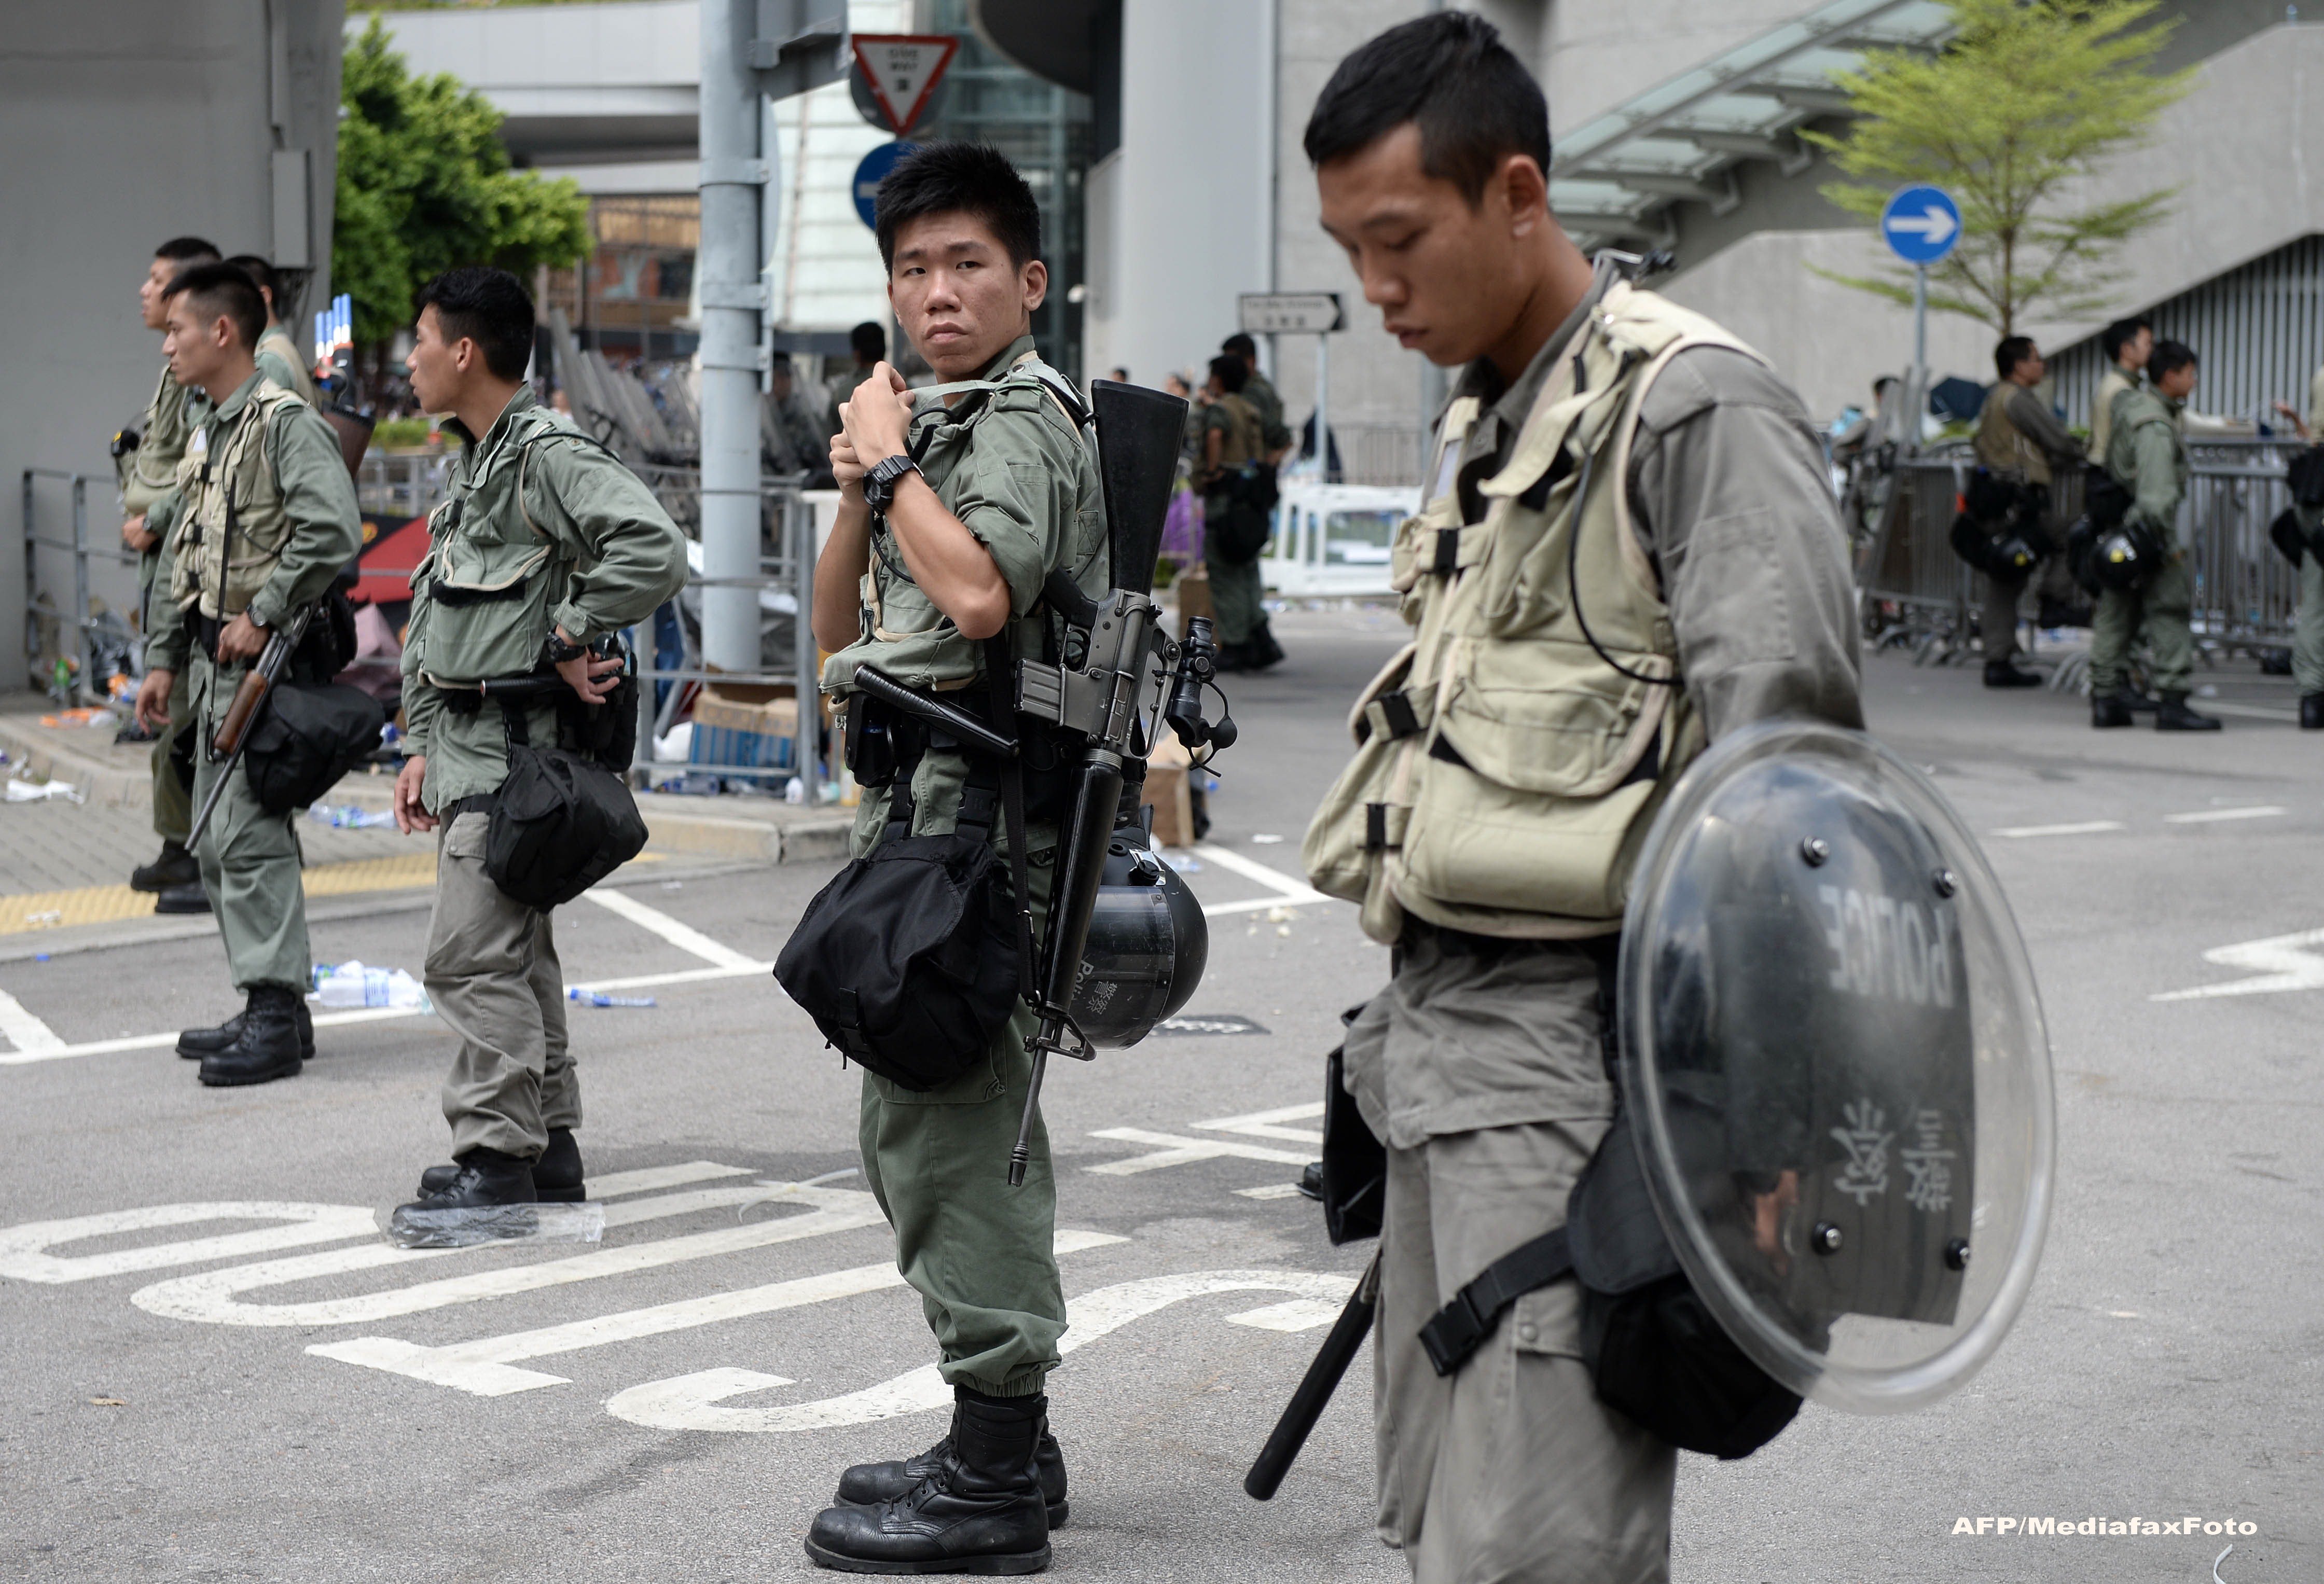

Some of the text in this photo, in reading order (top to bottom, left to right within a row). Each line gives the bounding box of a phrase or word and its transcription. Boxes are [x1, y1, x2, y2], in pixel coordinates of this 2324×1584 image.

[1087, 981, 1117, 1015] 警察
[1819, 886, 1953, 1008] POLICE
[1830, 1099, 1957, 1213] 警察
